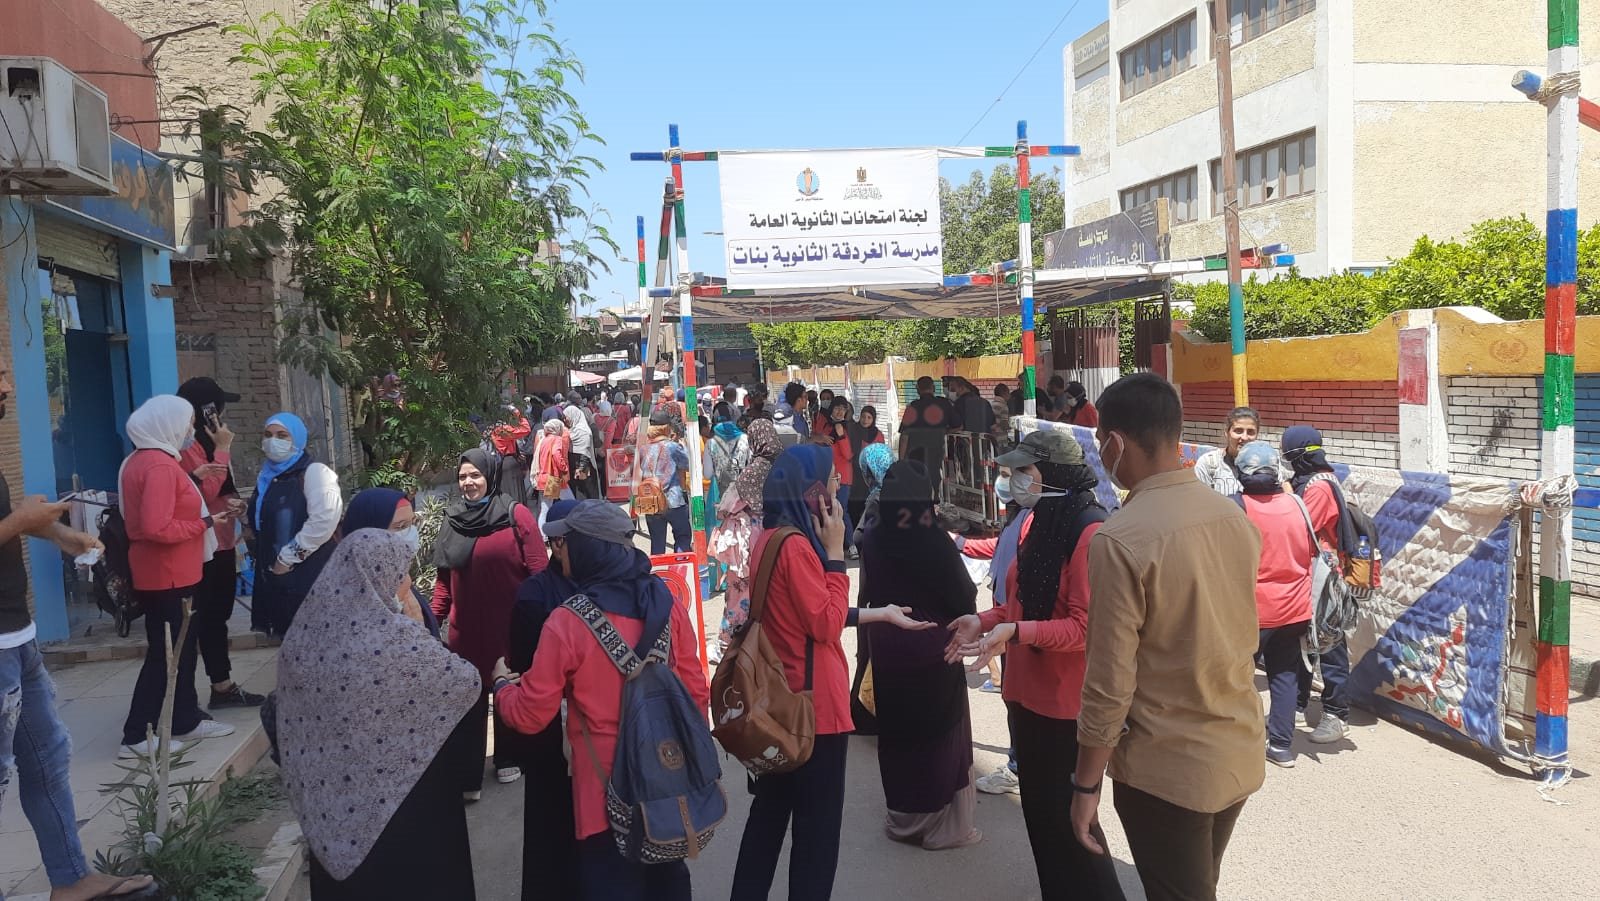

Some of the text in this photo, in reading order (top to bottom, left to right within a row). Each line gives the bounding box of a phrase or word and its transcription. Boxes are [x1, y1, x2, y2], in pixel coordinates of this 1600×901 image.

[749, 208, 928, 231] لجنة امتحانات الثانوية العامة
[1078, 228, 1110, 249] مدرسة
[733, 241, 939, 268] مدرسة الغردقة الثانوية بنات
